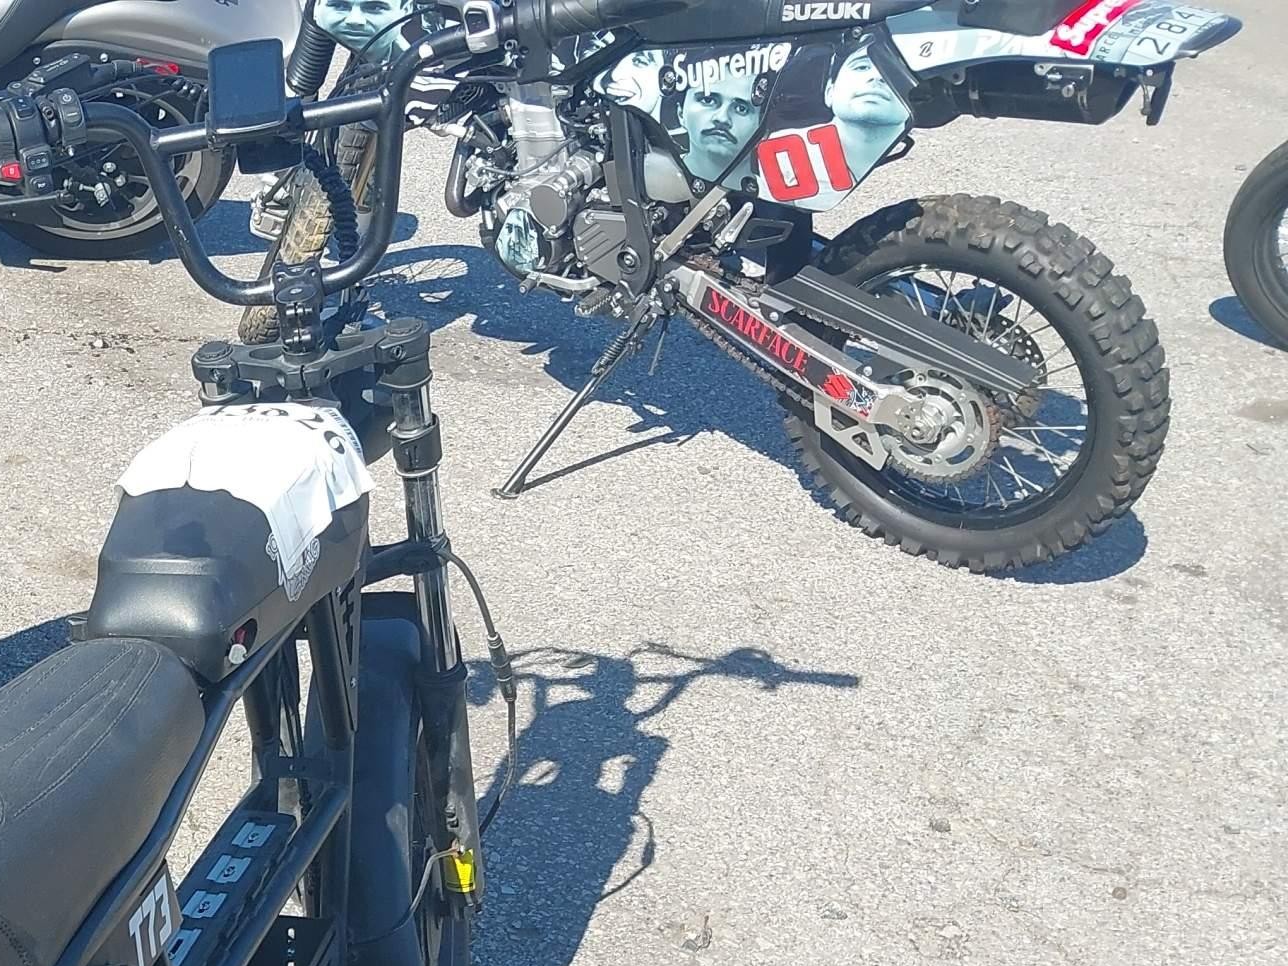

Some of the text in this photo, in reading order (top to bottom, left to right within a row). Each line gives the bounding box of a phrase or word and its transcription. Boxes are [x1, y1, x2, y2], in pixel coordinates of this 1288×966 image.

[781, 1, 872, 22] SUZUKI
[672, 42, 792, 95] Supreme
[756, 123, 853, 202] 01
[707, 288, 808, 372] SCARFACE
